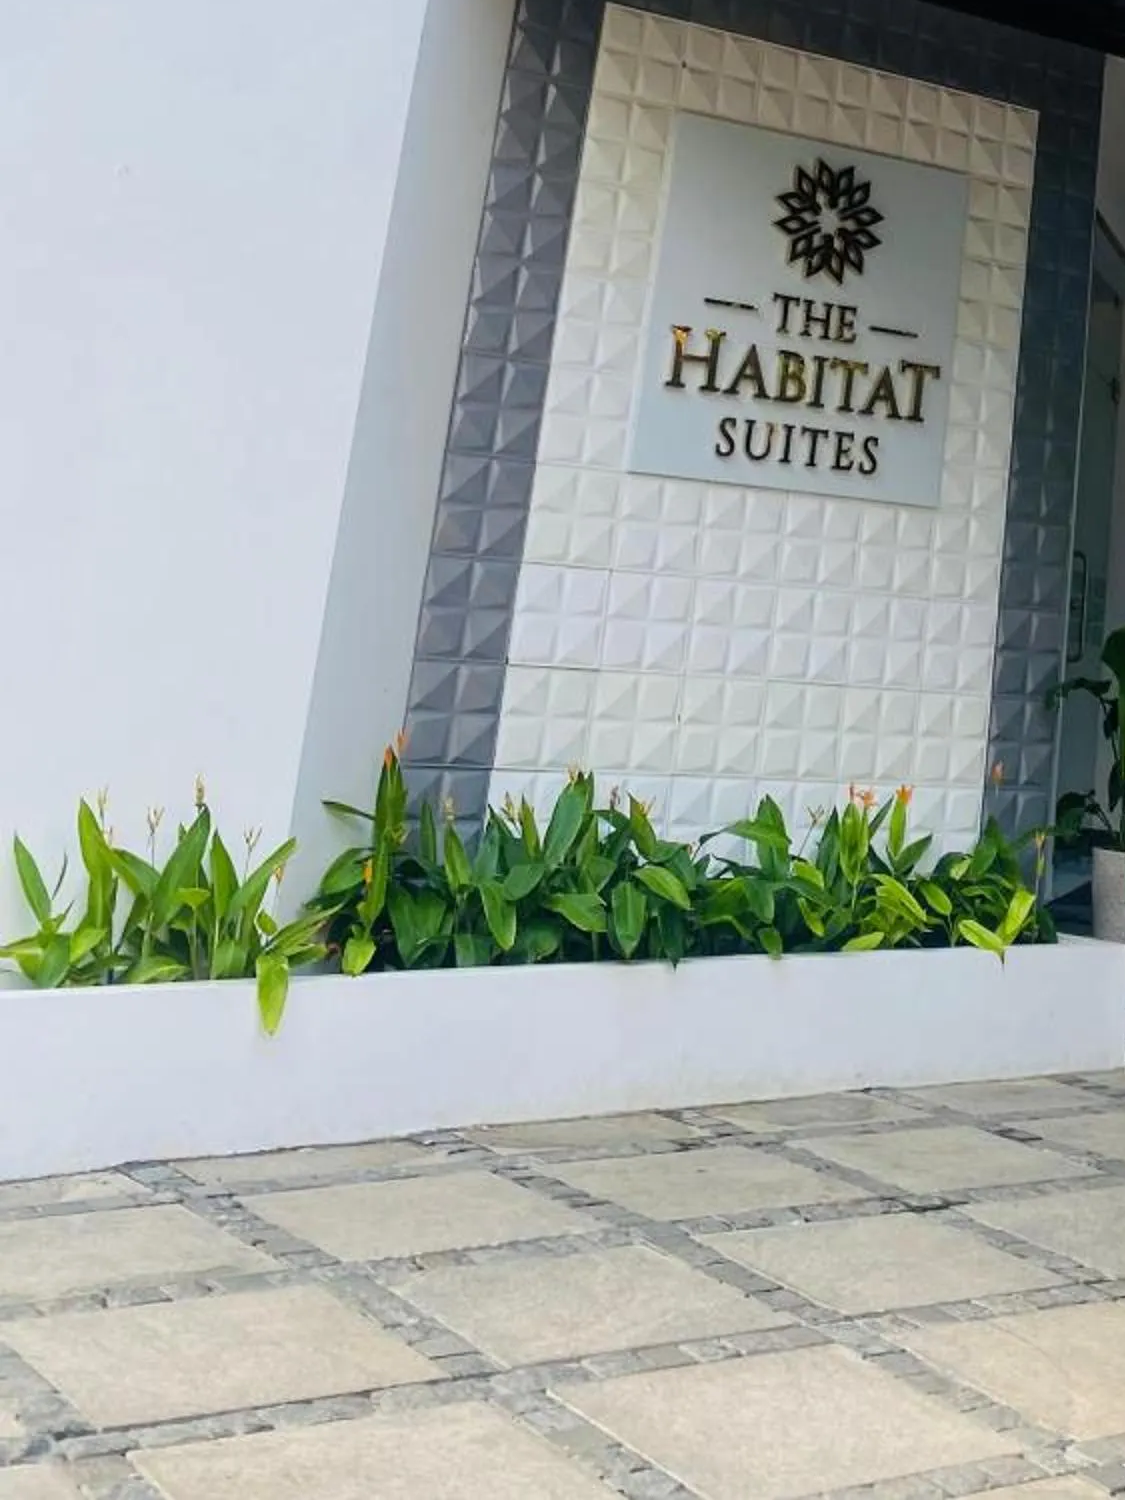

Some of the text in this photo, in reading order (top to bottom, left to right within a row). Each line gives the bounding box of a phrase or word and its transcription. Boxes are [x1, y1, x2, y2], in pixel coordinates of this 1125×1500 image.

[773, 292, 858, 343] THE
[665, 324, 941, 422] HABITAT
[715, 417, 880, 475] SUITES
